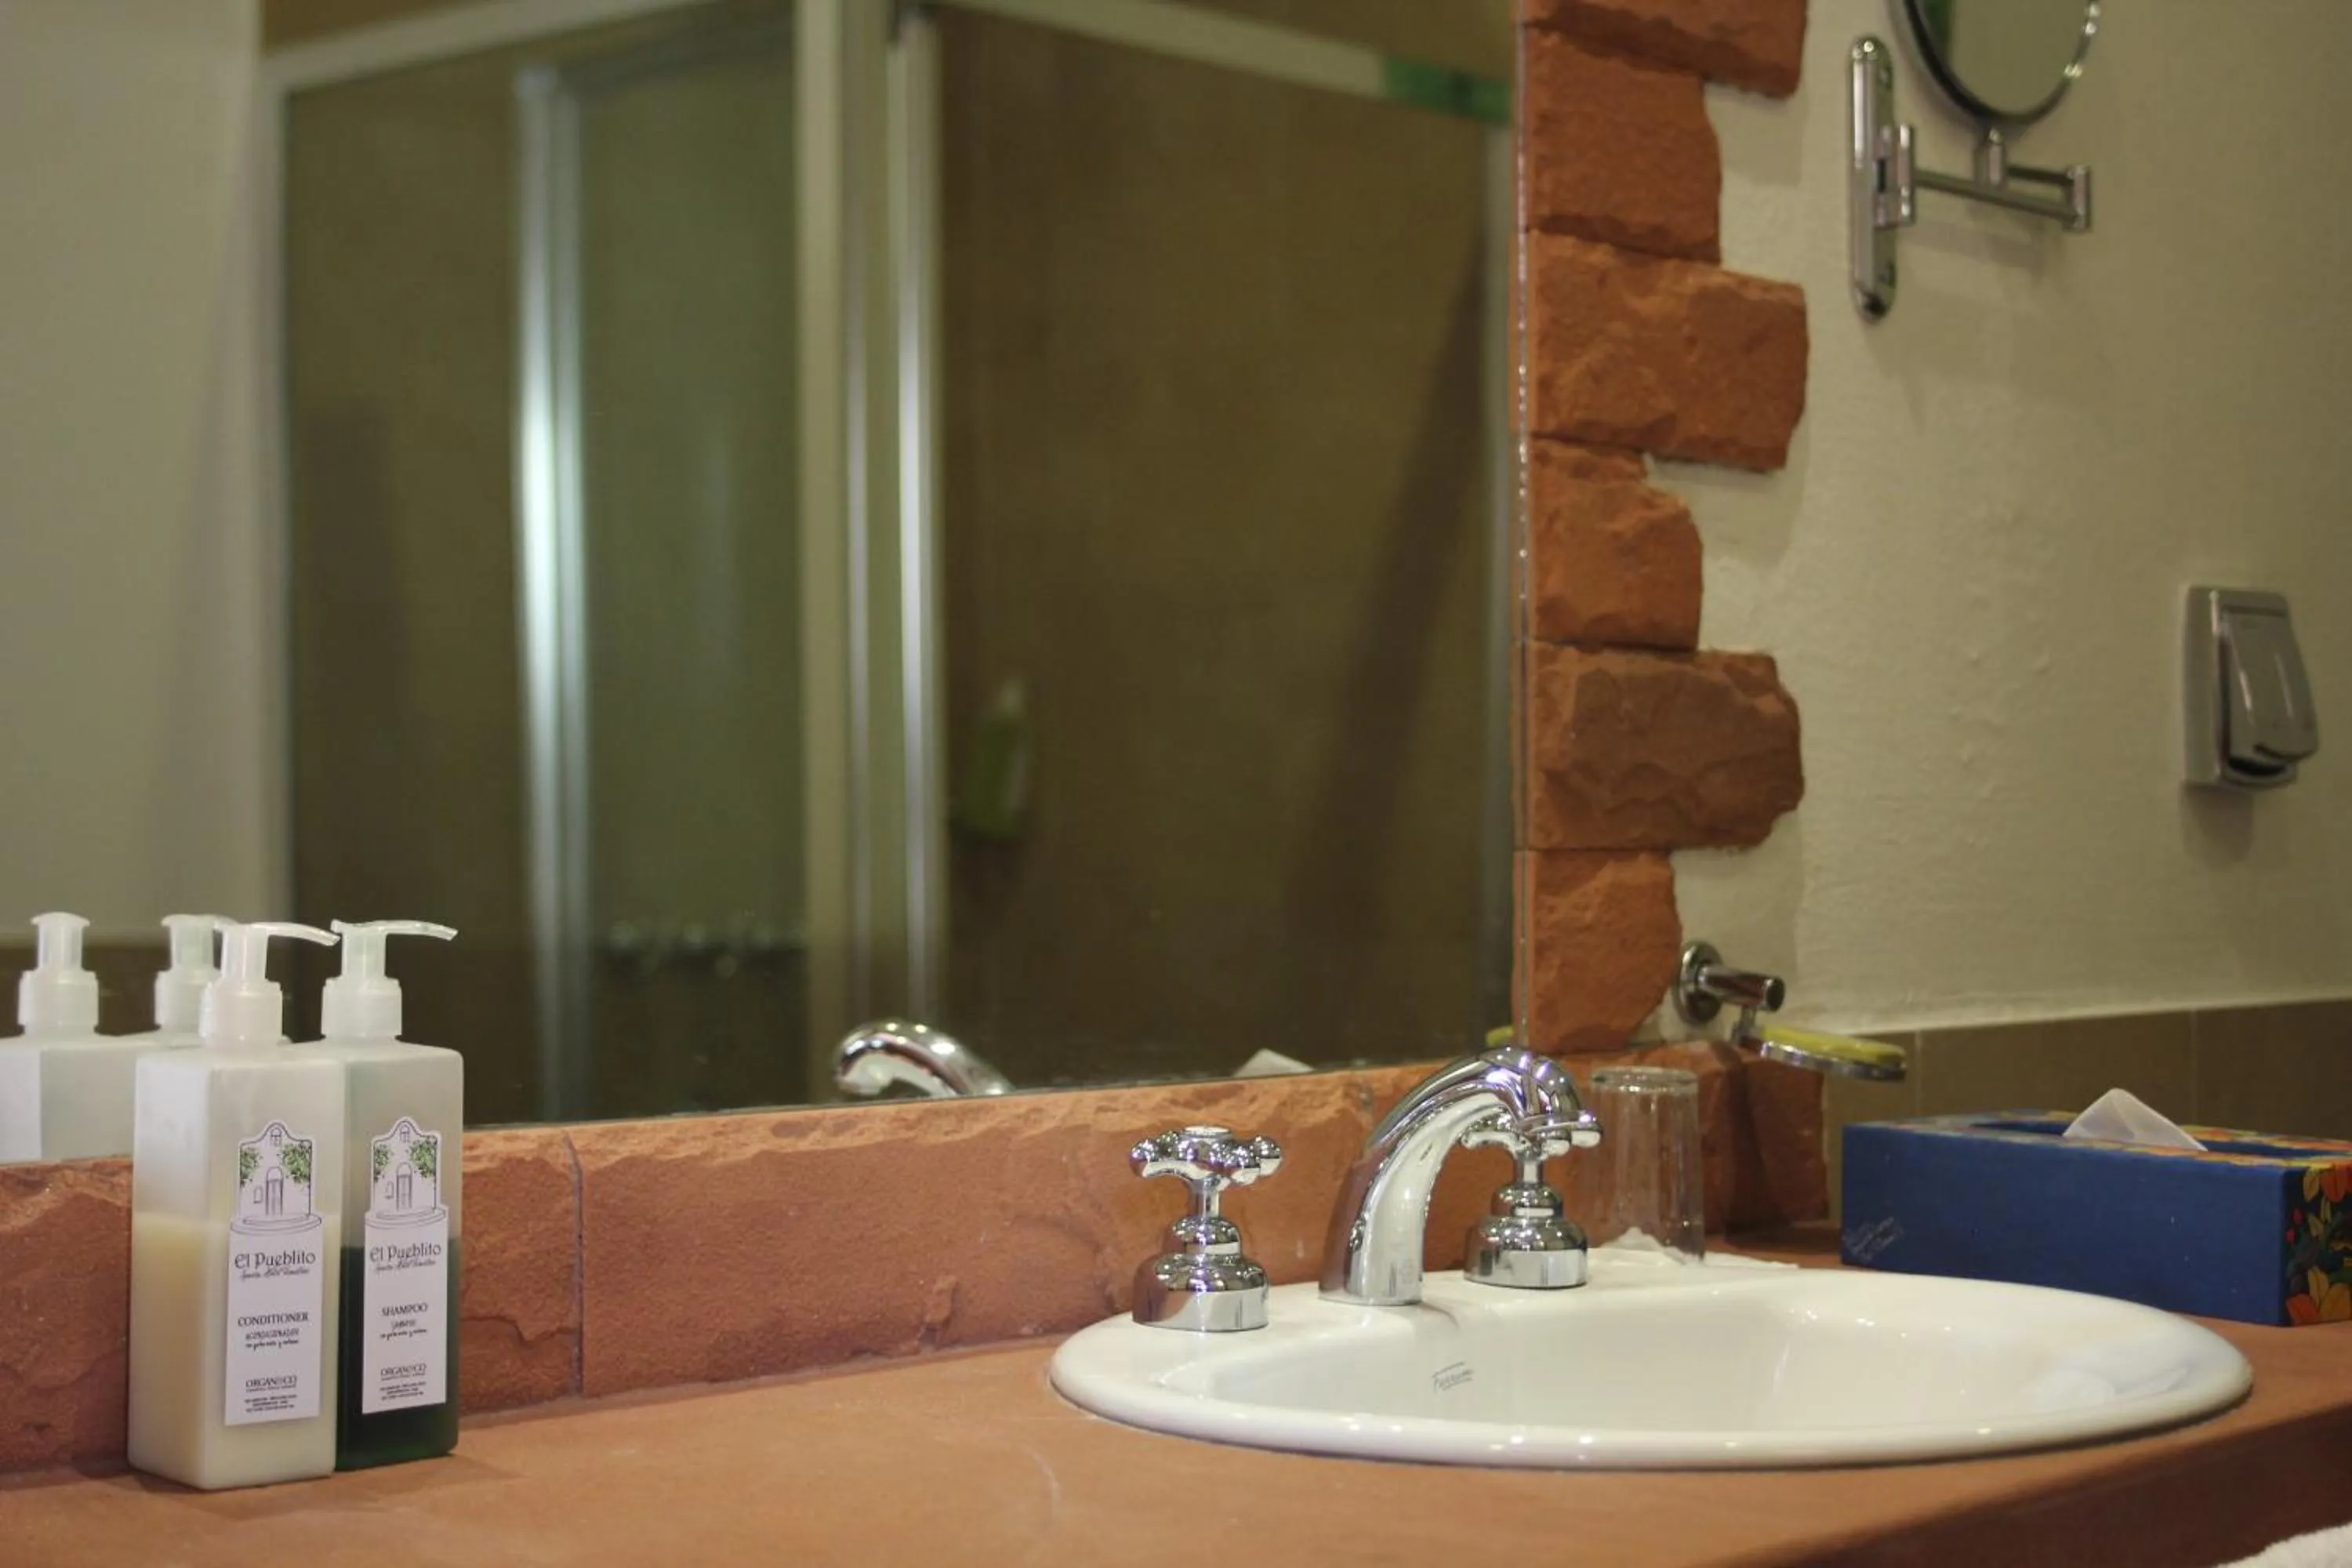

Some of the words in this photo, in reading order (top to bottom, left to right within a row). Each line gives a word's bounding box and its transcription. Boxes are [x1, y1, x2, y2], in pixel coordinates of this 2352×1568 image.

[234, 1253, 250, 1269] El
[255, 1249, 316, 1269] Pueblito
[369, 1245, 384, 1262] El
[388, 1242, 441, 1261] Pueblito
[382, 1302, 428, 1316] SHAMPOO
[238, 1312, 309, 1327] CONDITIONER
